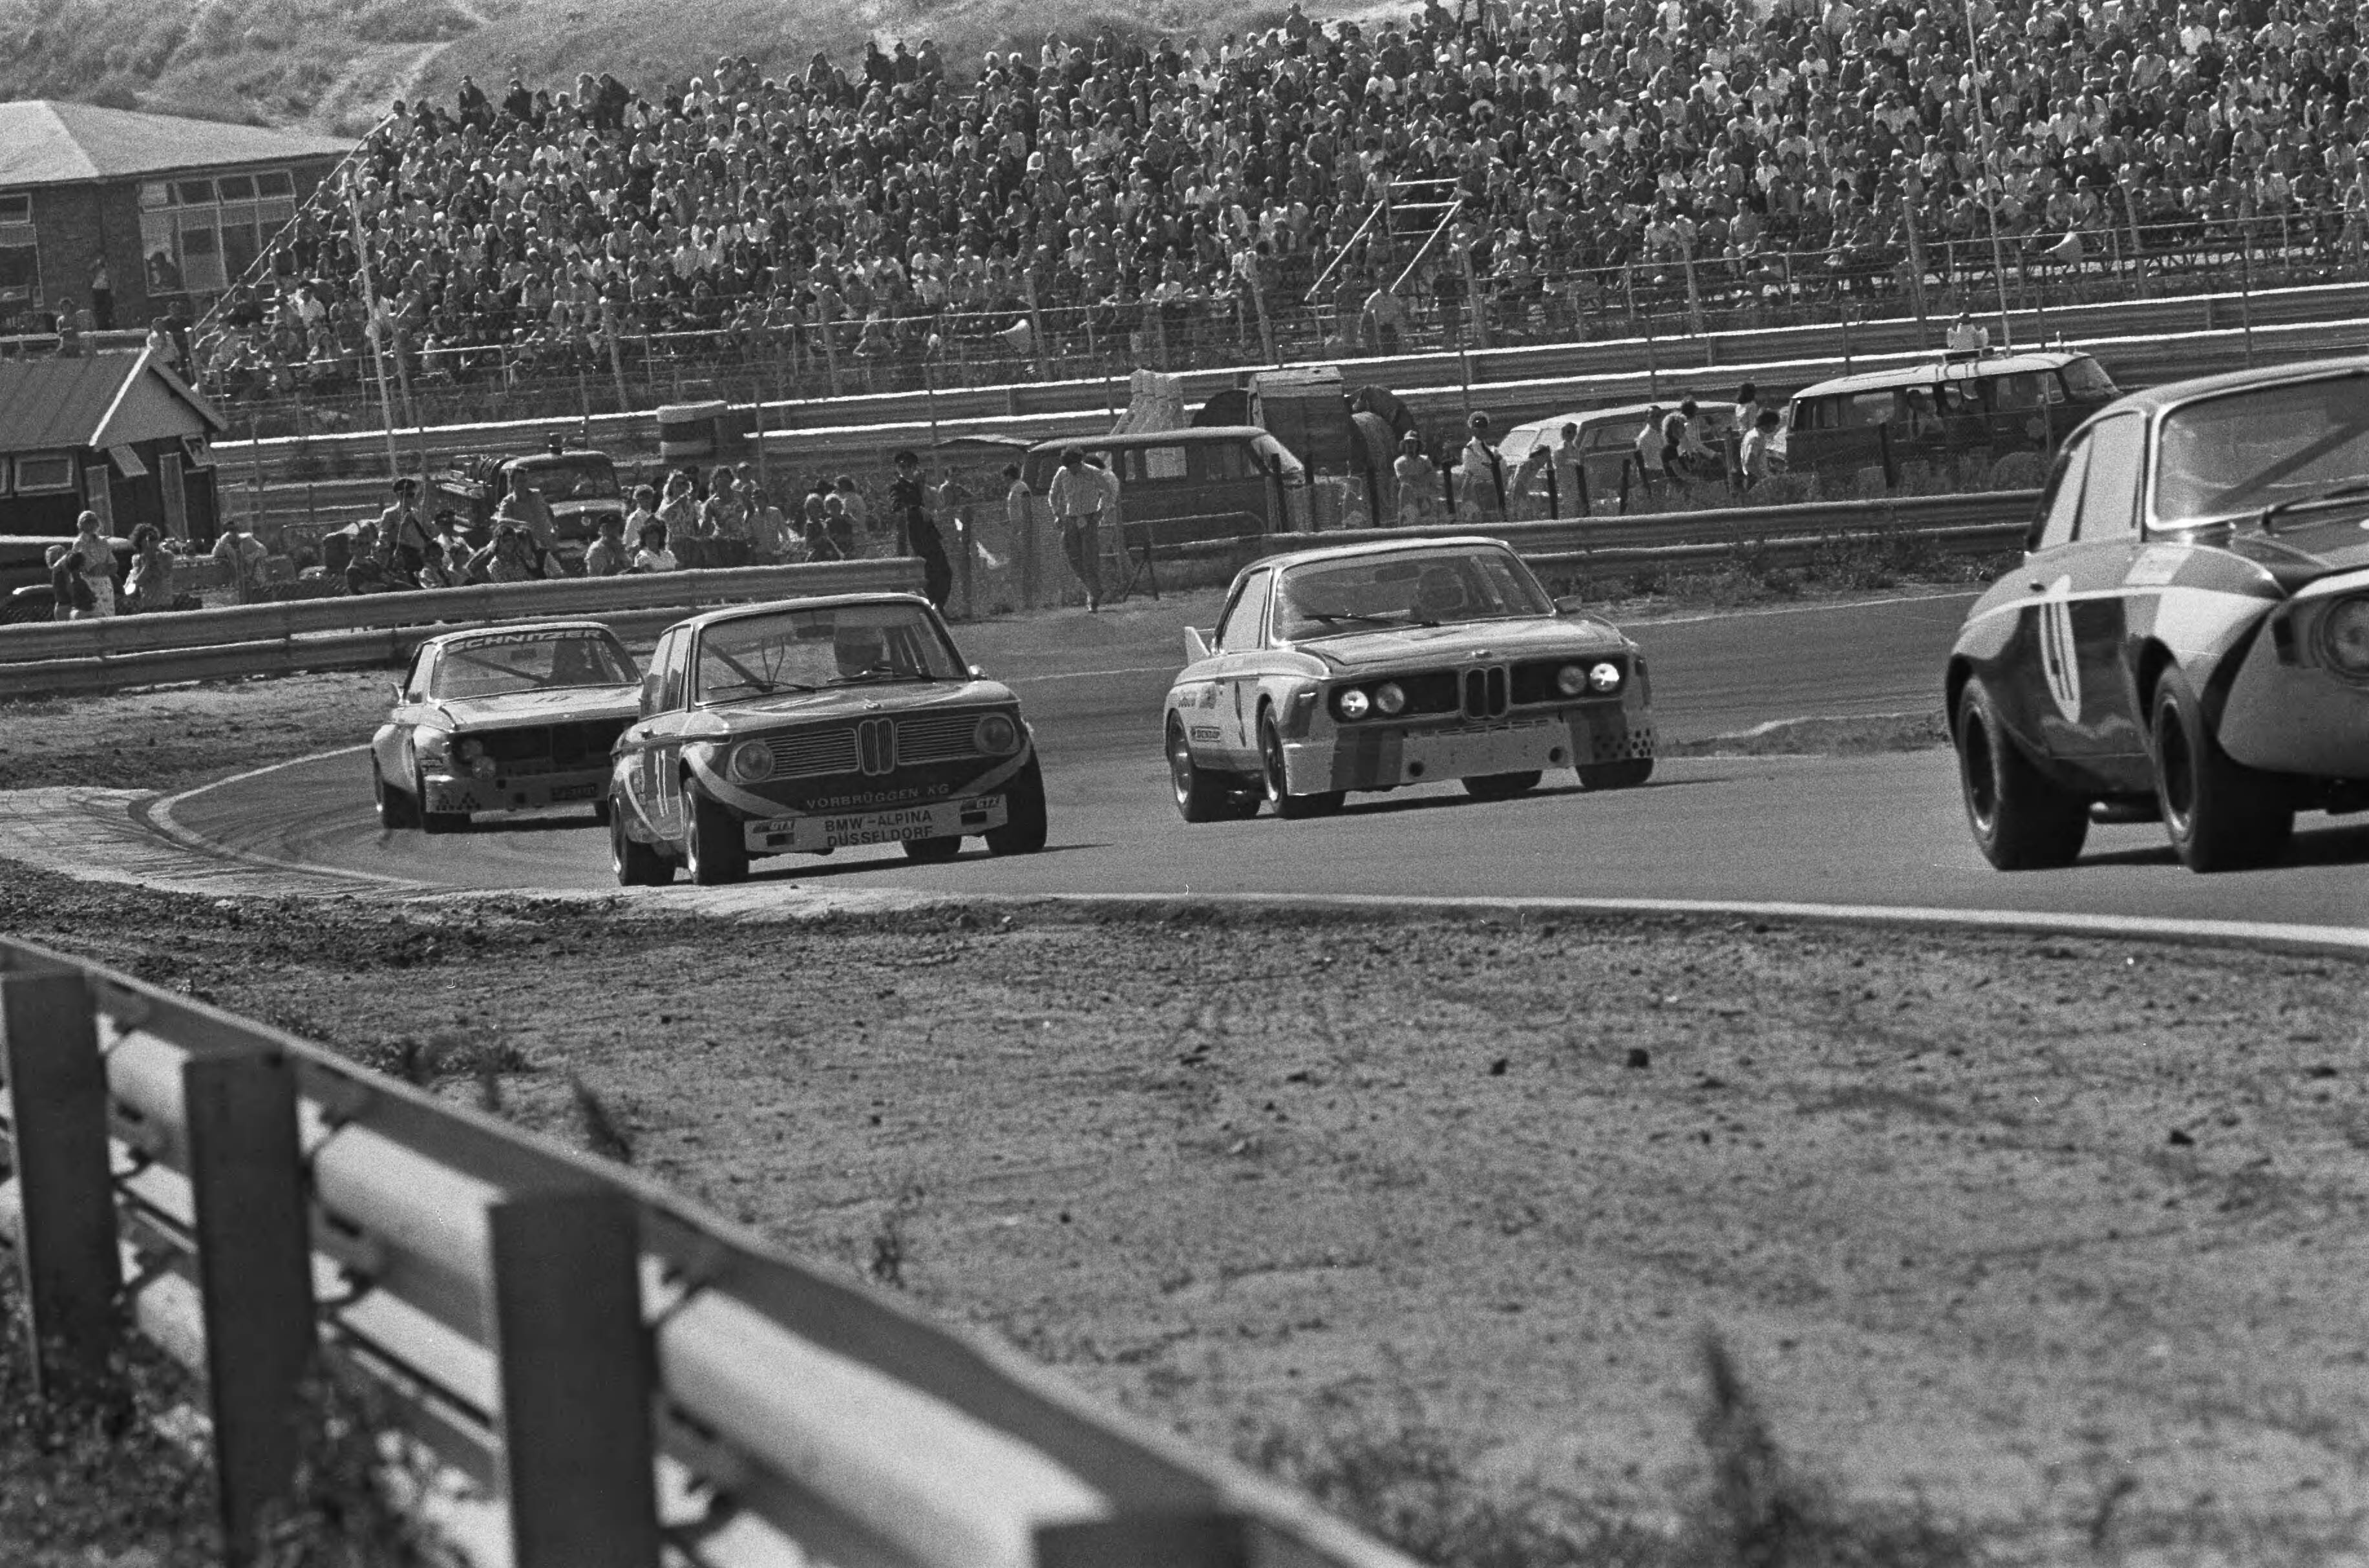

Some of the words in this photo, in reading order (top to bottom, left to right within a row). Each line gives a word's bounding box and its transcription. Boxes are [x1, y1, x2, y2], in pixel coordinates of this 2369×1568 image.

[447, 630, 602, 653] SCHNITZER
[807, 787, 919, 809] VORBRÜGGEN
[927, 783, 950, 796] KG
